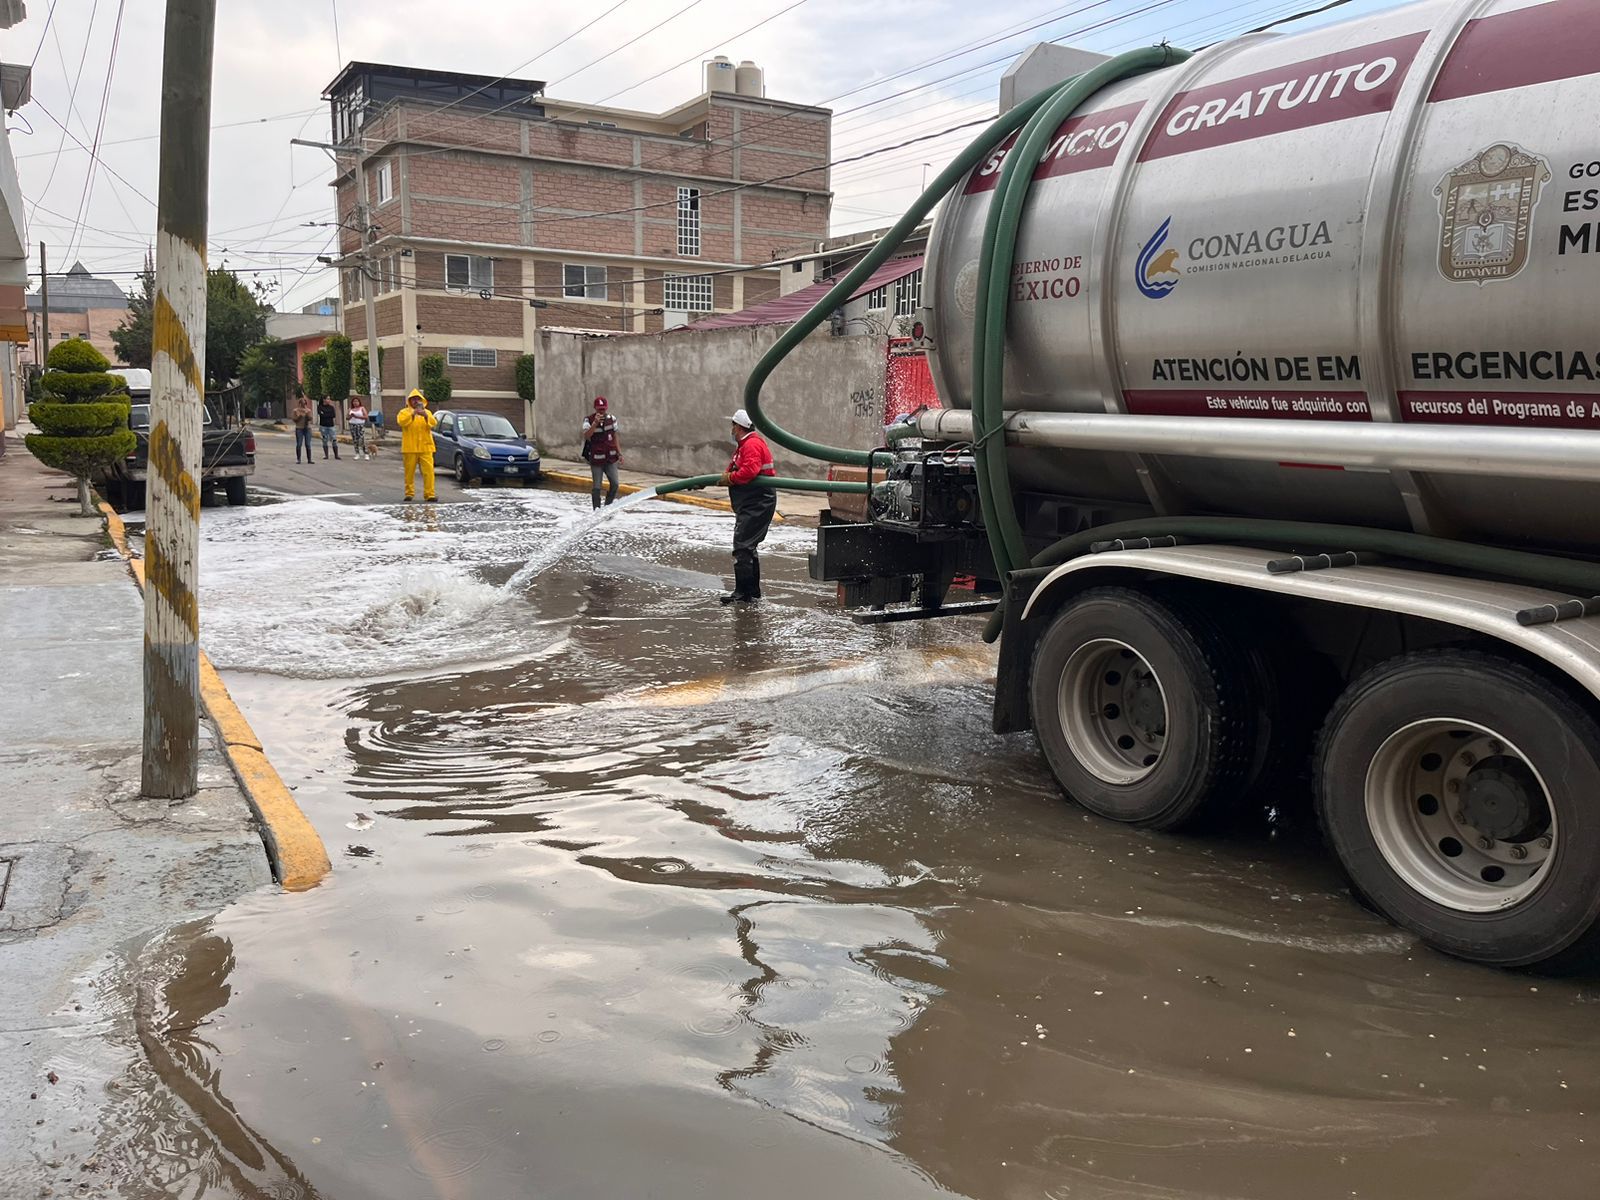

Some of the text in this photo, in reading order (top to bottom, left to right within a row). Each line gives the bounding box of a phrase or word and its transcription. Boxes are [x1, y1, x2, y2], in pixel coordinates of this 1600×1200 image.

[979, 57, 1397, 176] SVICIO GRATUITO
[1517, 177, 1533, 241] LIBERTAD
[1188, 220, 1333, 261] CONAGUA
[1012, 256, 1082, 276] BIERNO DE
[1232, 257, 1280, 269] NACIONAL
[1013, 276, 1080, 301] ÉXICO
[1152, 350, 1600, 381] ATENCIÓN DE EM ERGENCIA
[1206, 396, 1228, 409] Este
[1271, 396, 1289, 411] fue
[1292, 397, 1343, 415] adquirido
[1346, 401, 1368, 413] con
[1410, 400, 1463, 414] recursos
[1467, 399, 1488, 415] del
[1493, 399, 1561, 419] Programa
[1566, 401, 1585, 418] de
